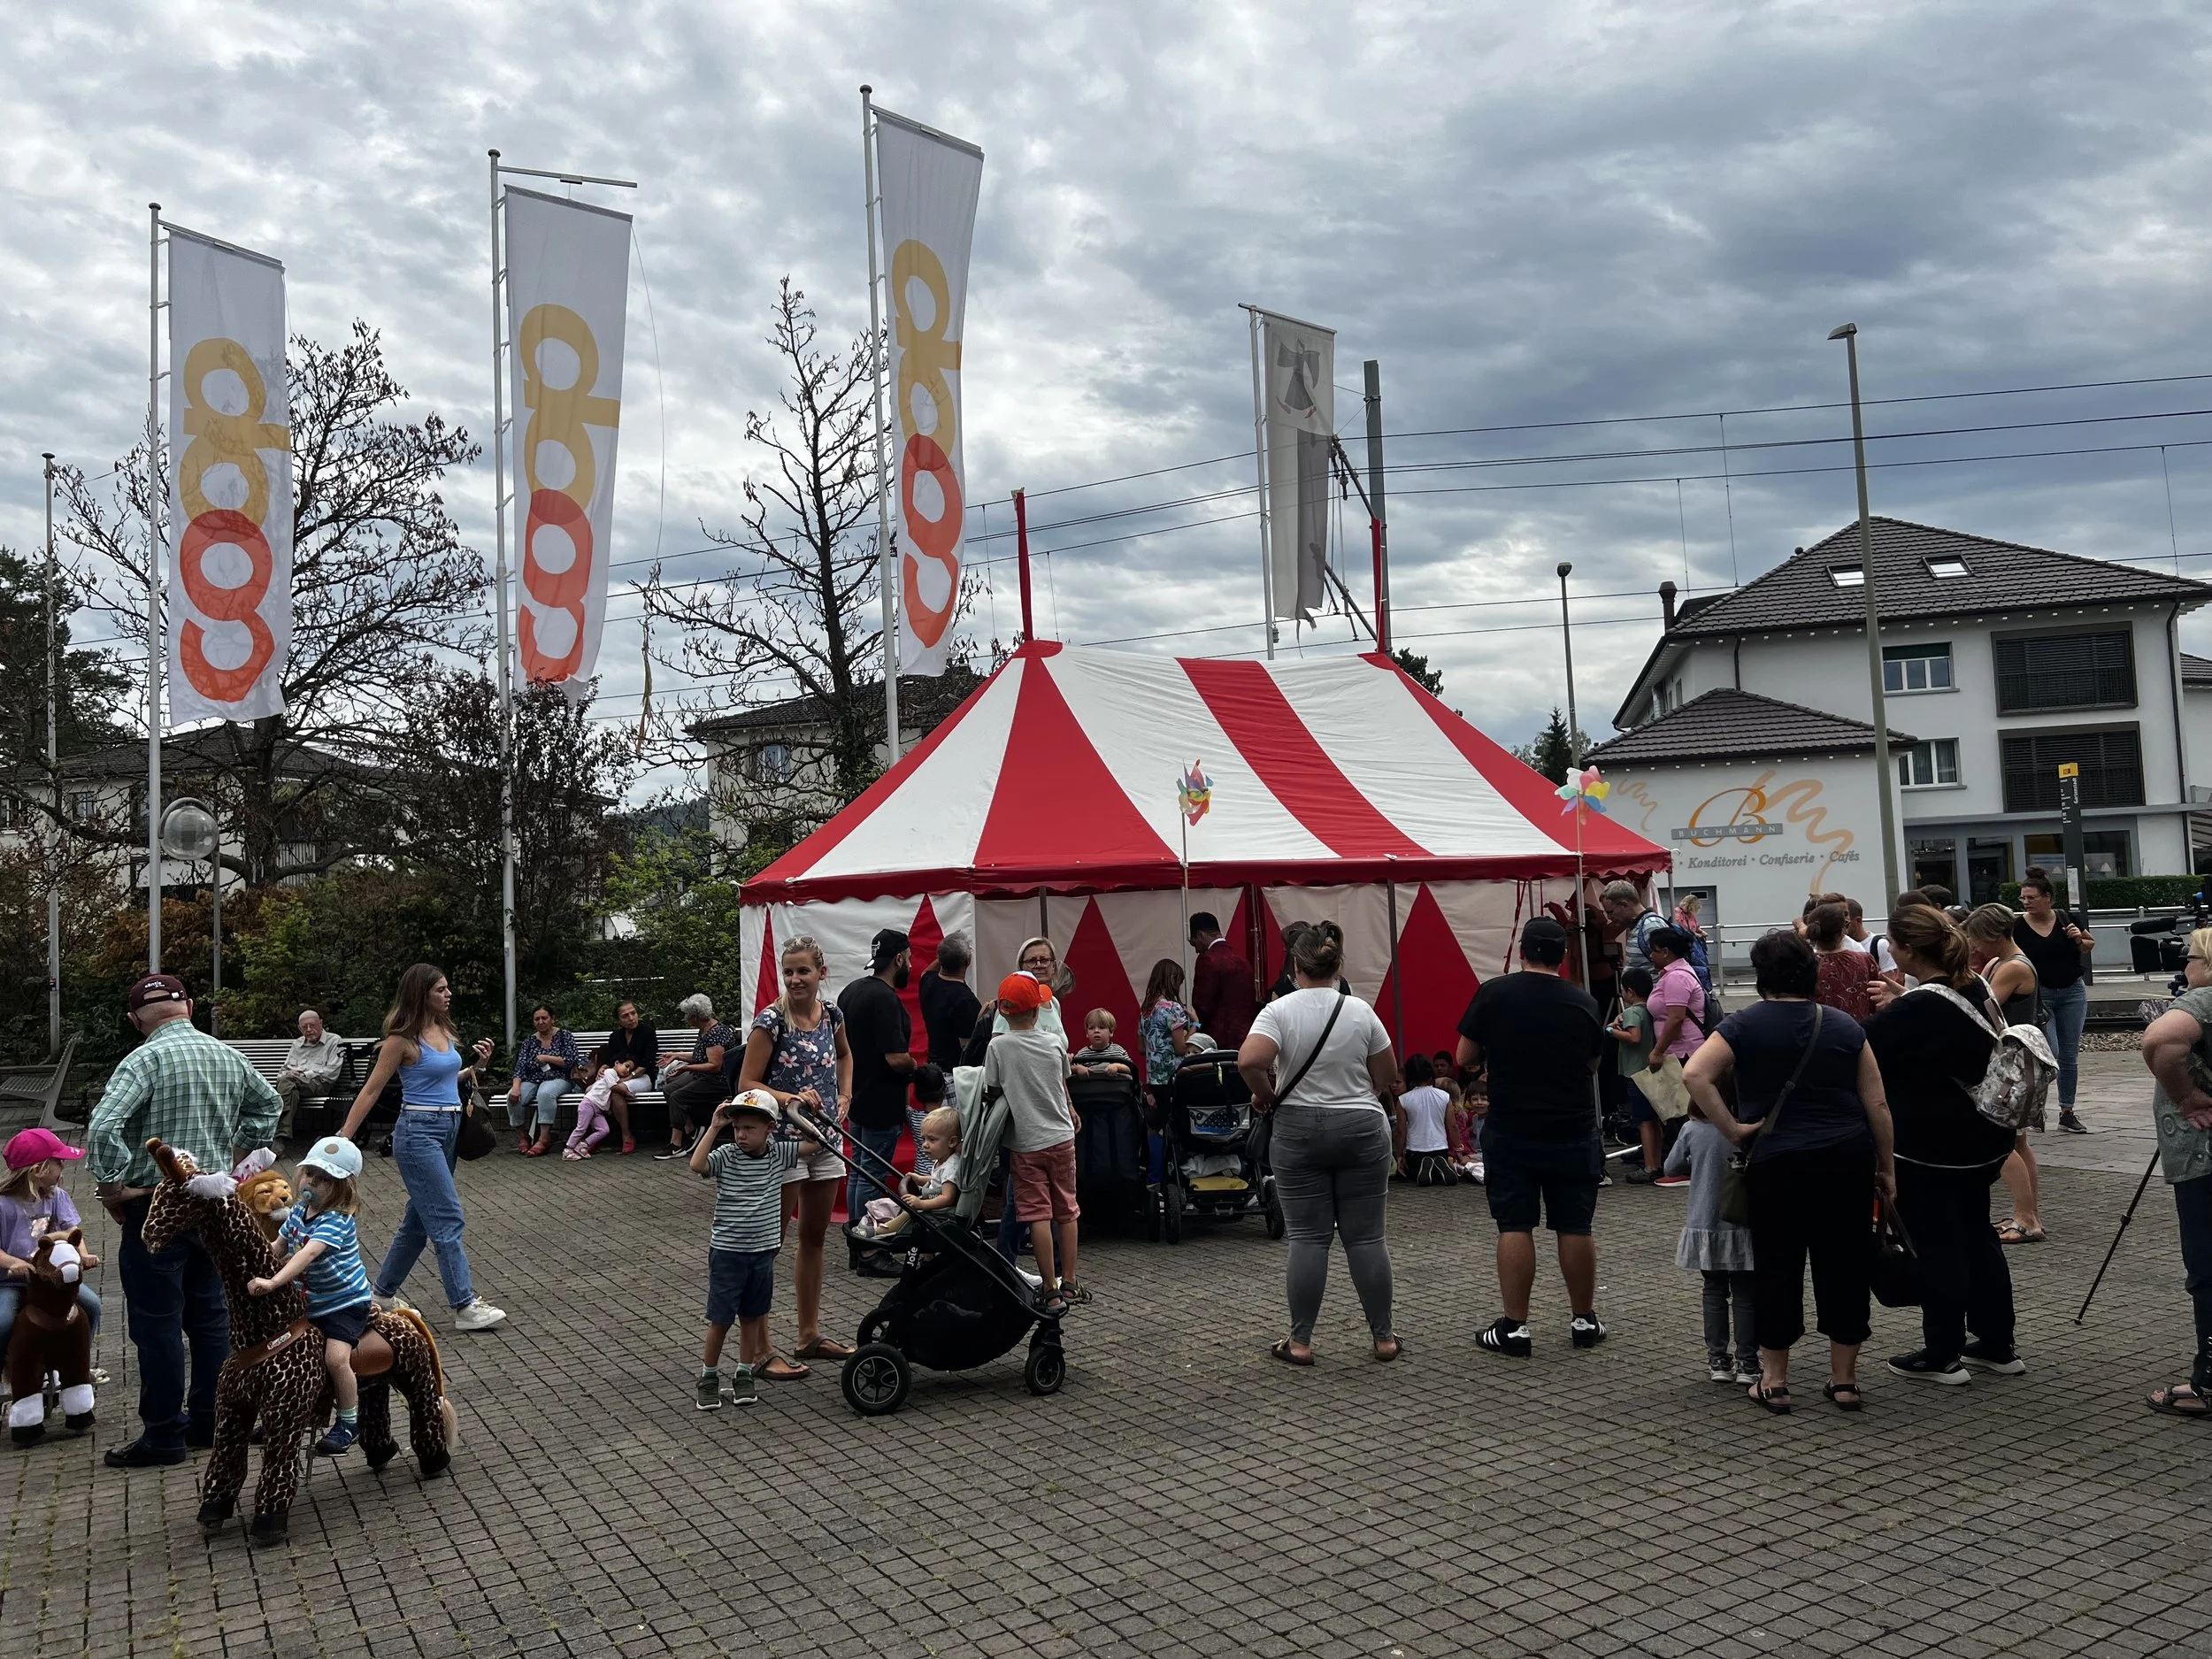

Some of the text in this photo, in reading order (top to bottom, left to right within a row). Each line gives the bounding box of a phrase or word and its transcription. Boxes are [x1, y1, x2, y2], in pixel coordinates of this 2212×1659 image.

[179, 338, 291, 703] coop
[518, 303, 621, 683] coop
[891, 239, 962, 649] coop
[1678, 826, 1777, 838] BUCHMANN
[1687, 855, 1747, 869] Konditorei
[1759, 852, 1815, 867] Confiserie
[907, 1247, 918, 1267] Joie
